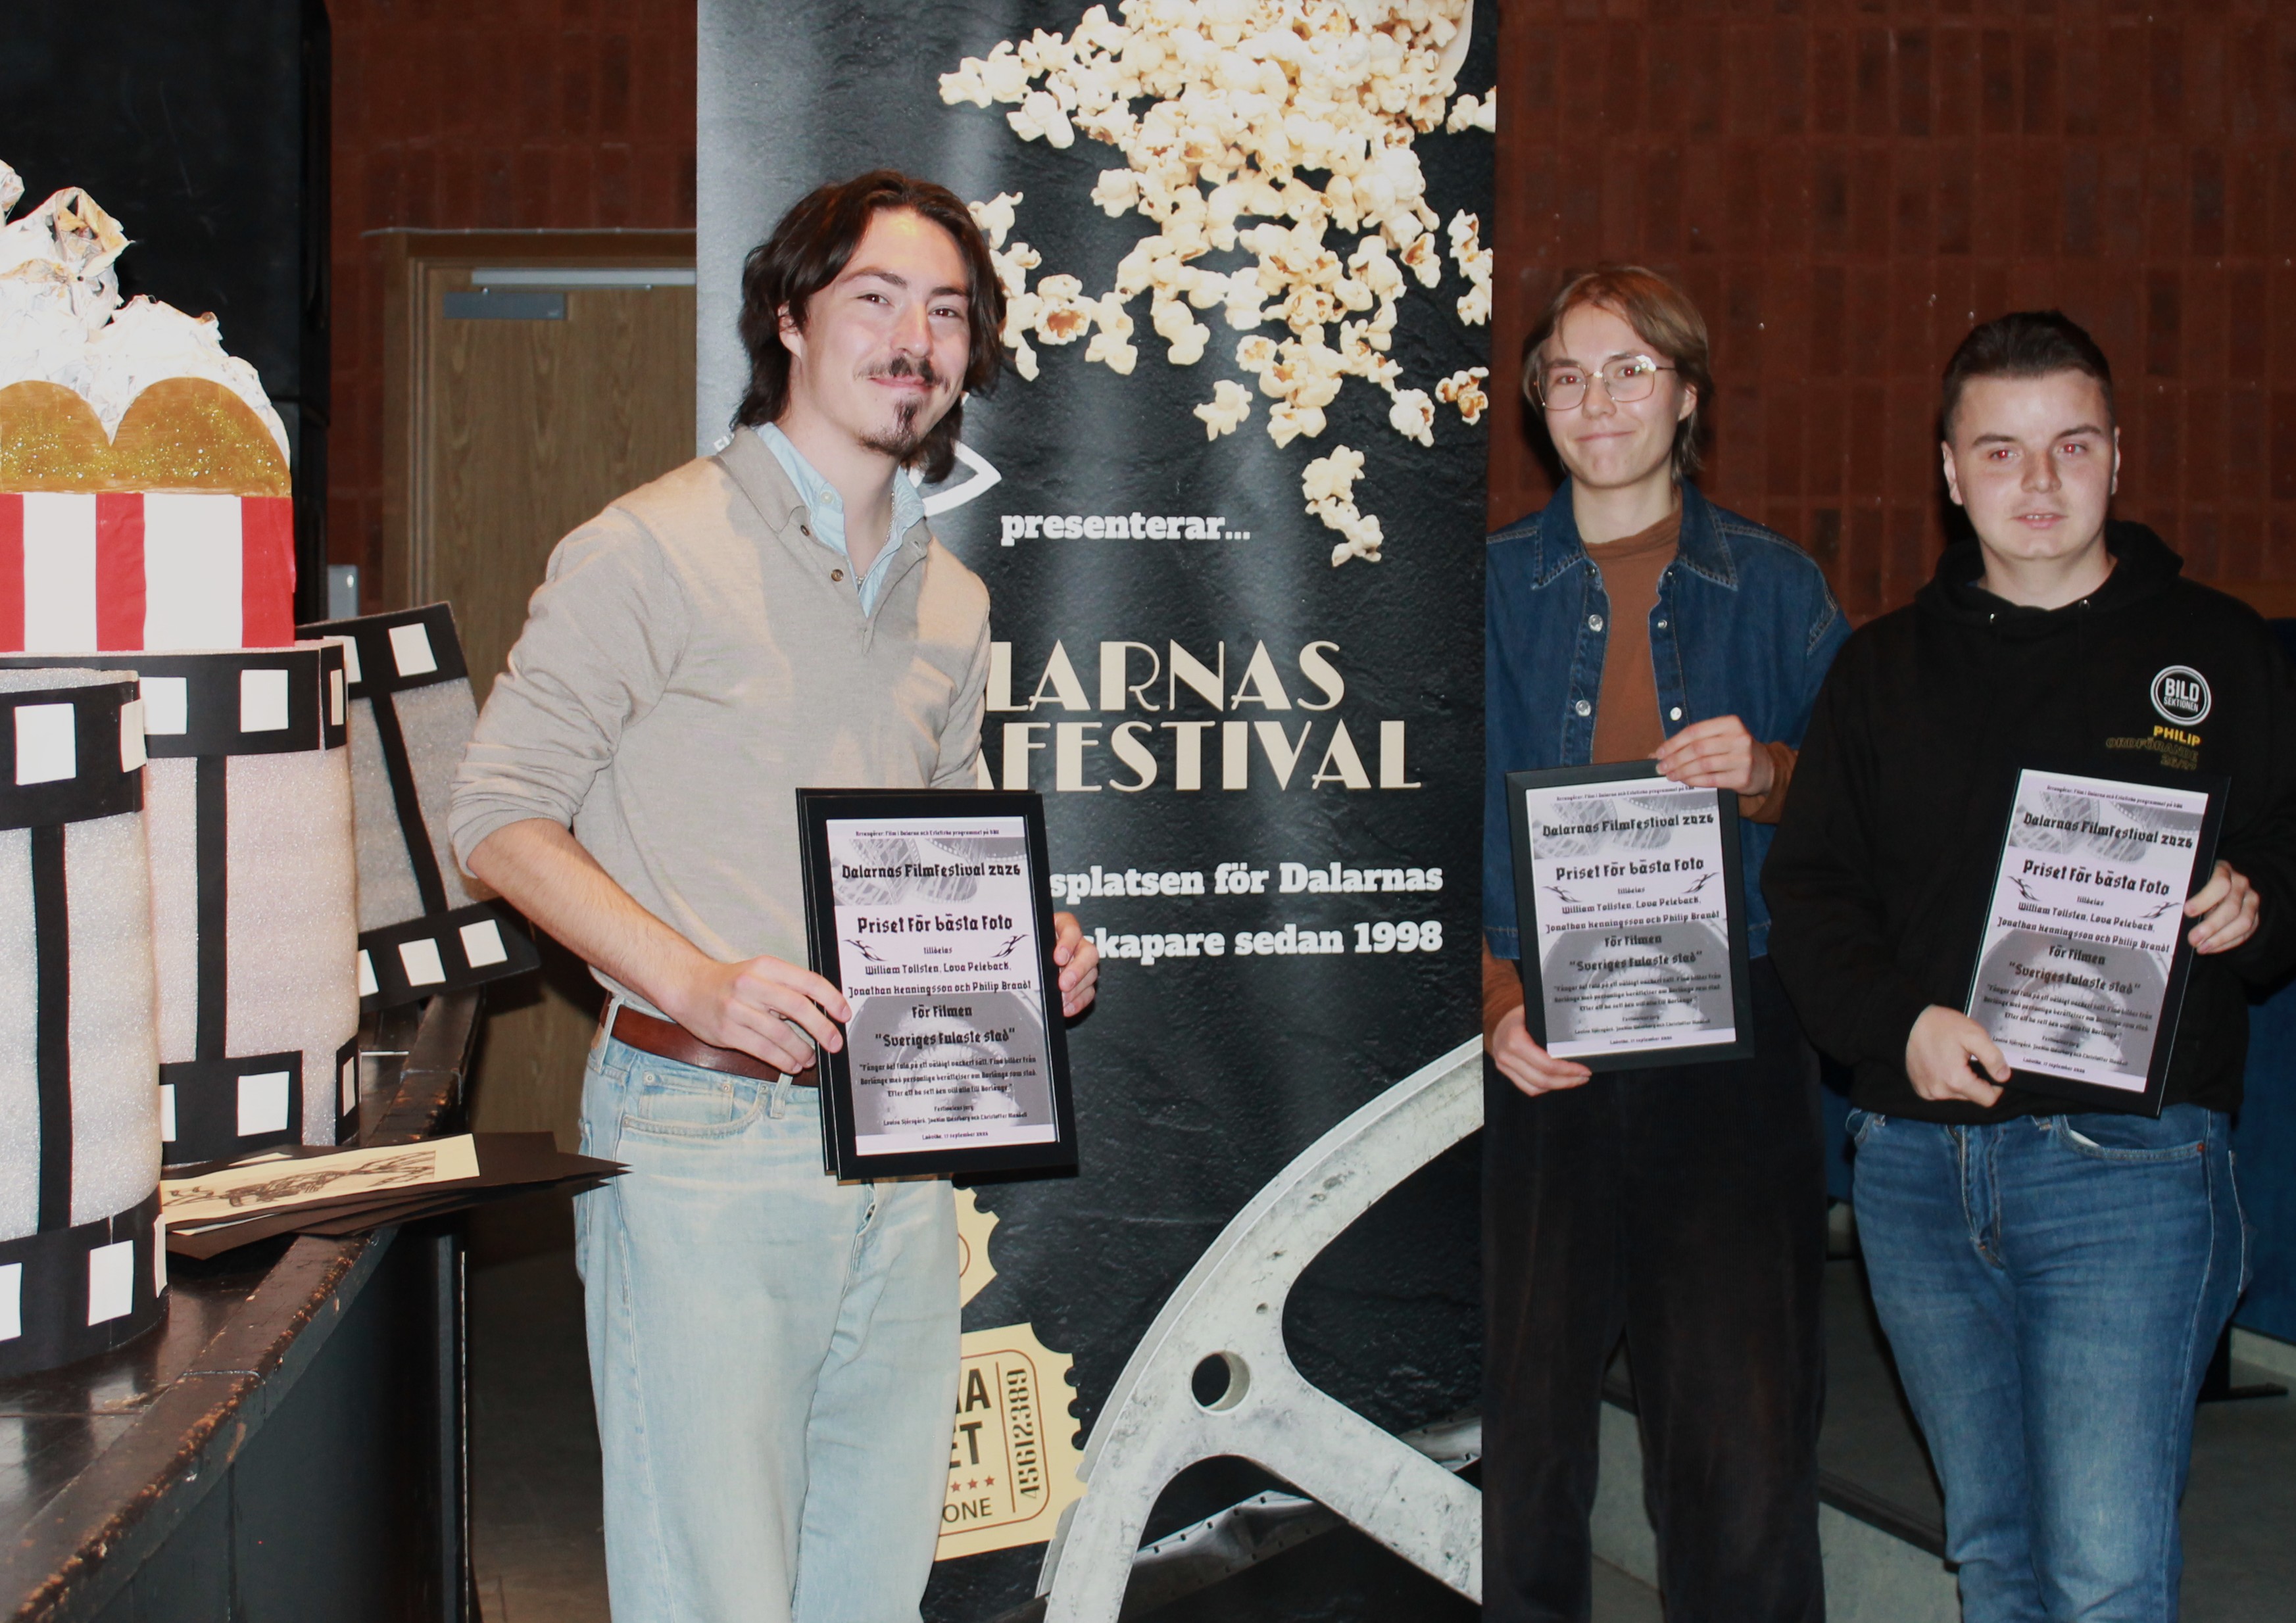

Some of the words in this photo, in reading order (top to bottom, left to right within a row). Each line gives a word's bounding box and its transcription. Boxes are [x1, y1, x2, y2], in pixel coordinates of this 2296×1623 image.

[1000, 512, 1250, 546] presenterar...
[986, 639, 1345, 712] LARNAS
[2164, 677, 2200, 702] BILD
[2163, 696, 2199, 712] SEKTIONEN
[2153, 725, 2201, 747] PHILIP
[1542, 822, 1600, 838] Dalarnas
[1601, 814, 1680, 833] Filmfestival
[1682, 813, 1714, 826] 2026
[2022, 811, 2080, 832] Dalarnas
[2080, 819, 2159, 844] Filmfestival
[2161, 834, 2193, 849] 2026
[842, 864, 902, 880] Dalarnas
[904, 862, 985, 878] Filmfestival
[988, 863, 1021, 876] 2026
[1215, 862, 1269, 895] för
[1279, 861, 1443, 894] Dalarnas
[1555, 864, 1600, 881] Priset
[1603, 861, 1626, 877] för
[1629, 859, 1671, 875] bästa
[1674, 857, 1704, 871] foto
[2022, 859, 2068, 880] Priset
[2068, 866, 2092, 884] för
[2094, 870, 2137, 891] bästa
[2139, 878, 2170, 896] foto
[2077, 896, 2105, 907] tilldelas
[857, 917, 904, 934] Priset
[908, 914, 931, 933] för
[935, 913, 979, 932] bästa
[981, 914, 1013, 931] foto
[1545, 922, 1586, 934] Jonathan
[1588, 918, 1644, 929] Henningsson
[1646, 915, 1661, 925] och
[1663, 913, 1689, 924] Philip
[1691, 909, 1720, 921] Brandt
[1083, 927, 1225, 965] kapare
[1234, 923, 1344, 955] sedan
[1354, 920, 1443, 953] 1998
[1604, 934, 1623, 948] för
[1624, 934, 1663, 946] filmen
[1997, 916, 2037, 931] Jonathan
[2038, 923, 2093, 940] Henningsson
[2095, 934, 2111, 943] och
[2111, 935, 2138, 950] Philip
[2139, 940, 2170, 954] Brandt
[1569, 958, 1628, 973] "Sveriges
[1628, 954, 1669, 968] fulaste
[1672, 950, 1703, 964] stad"
[2048, 944, 2067, 958] för
[2067, 948, 2106, 965] filmen
[865, 965, 900, 976] William
[902, 963, 942, 974] Tollsten,
[943, 962, 966, 973] Lova
[2009, 961, 2065, 986] "Sveriges
[2064, 972, 2107, 990] fulaste
[2108, 981, 2141, 995] stad"
[848, 986, 892, 999] Jonathan
[893, 984, 953, 997] Henningsson
[954, 982, 971, 992] och
[972, 981, 999, 994] Philip
[1001, 980, 1031, 990] Brandt
[912, 1004, 931, 1019] för
[933, 1004, 973, 1018] filmen
[875, 1032, 937, 1050] "Sveriges
[938, 1030, 981, 1045] fulaste
[983, 1027, 1015, 1043] stad"
[1006, 1369, 1040, 1499] 45612389
[942, 1497, 992, 1523] ONE
